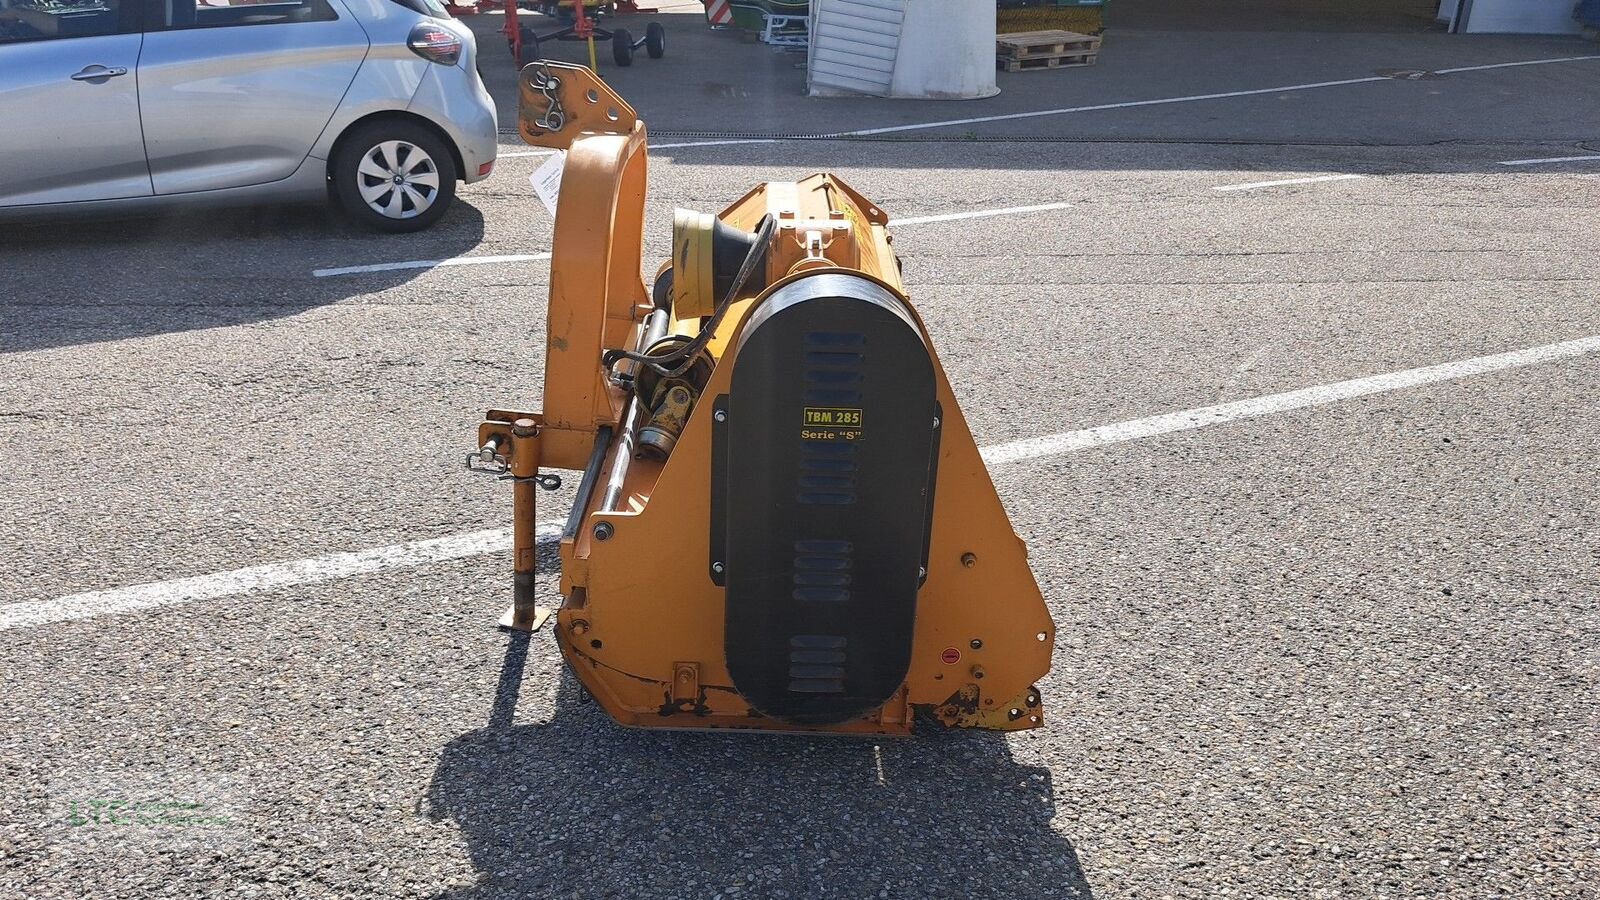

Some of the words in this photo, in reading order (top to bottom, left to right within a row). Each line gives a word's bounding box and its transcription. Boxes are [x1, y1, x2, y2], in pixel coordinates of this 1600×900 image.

[807, 411, 832, 423] TBM
[836, 412, 859, 424] 285
[801, 430, 835, 440] Serie
